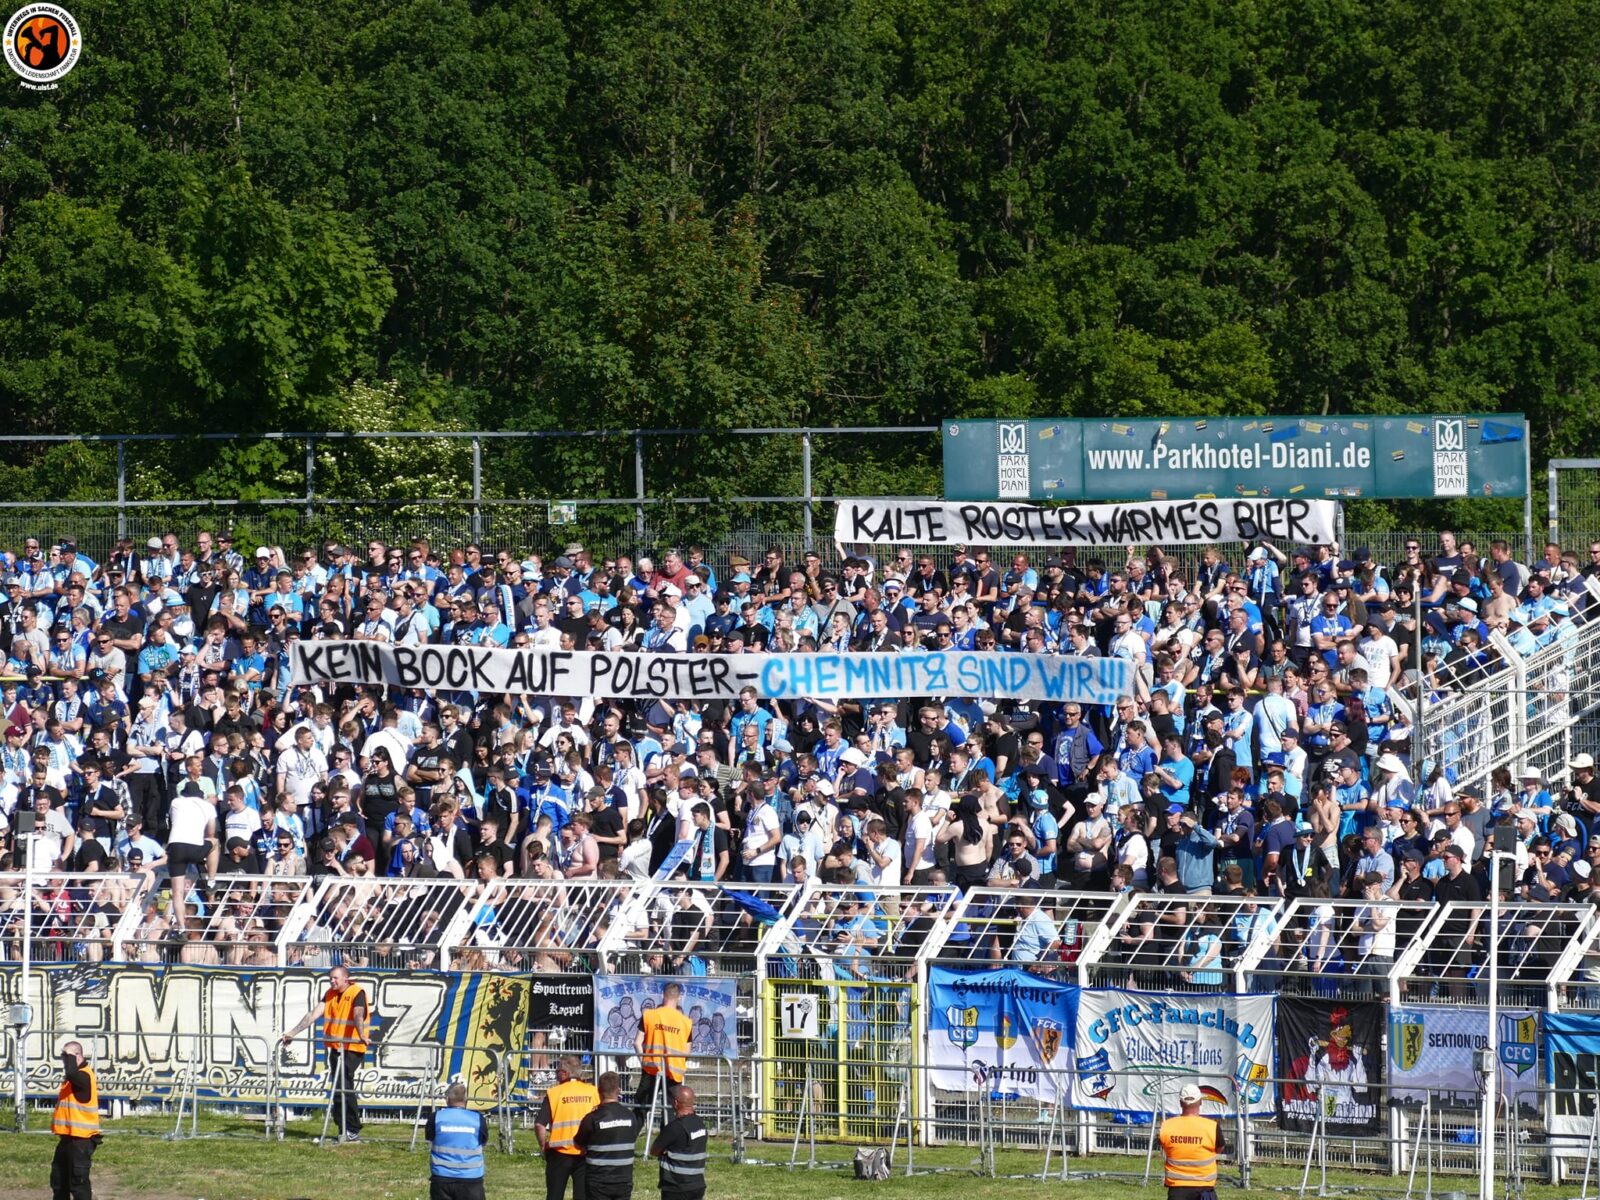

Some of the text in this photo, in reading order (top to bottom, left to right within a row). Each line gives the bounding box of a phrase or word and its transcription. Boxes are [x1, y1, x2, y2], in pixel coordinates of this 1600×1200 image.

[1000, 455, 1027, 466] PARK
[1088, 440, 1371, 470] www.Parkhotel-Diani.de
[1436, 452, 1465, 463] PARK
[1000, 467, 1027, 479] HOTEL
[1436, 464, 1465, 476] HOTEL
[1001, 480, 1028, 491] DIANI
[1437, 477, 1465, 488] DIANI
[852, 505, 948, 542] KALTE
[1233, 499, 1320, 542] BIER.
[301, 643, 384, 682] KEIN
[397, 648, 496, 688] BOCK
[505, 652, 573, 693] AUF
[957, 656, 1031, 695] SIND
[1036, 658, 1125, 701] WIR!!!
[785, 1002, 811, 1029] 17
[1391, 1013, 1418, 1024] FCK
[654, 1023, 681, 1035] SECURITY
[1036, 1018, 1058, 1030] FCK
[952, 1029, 974, 1040] CFC
[1504, 1046, 1532, 1061] CFC
[287, 1077, 330, 1097] und
[561, 1095, 592, 1105] SECURITY
[1170, 1135, 1203, 1145] SECURITY
